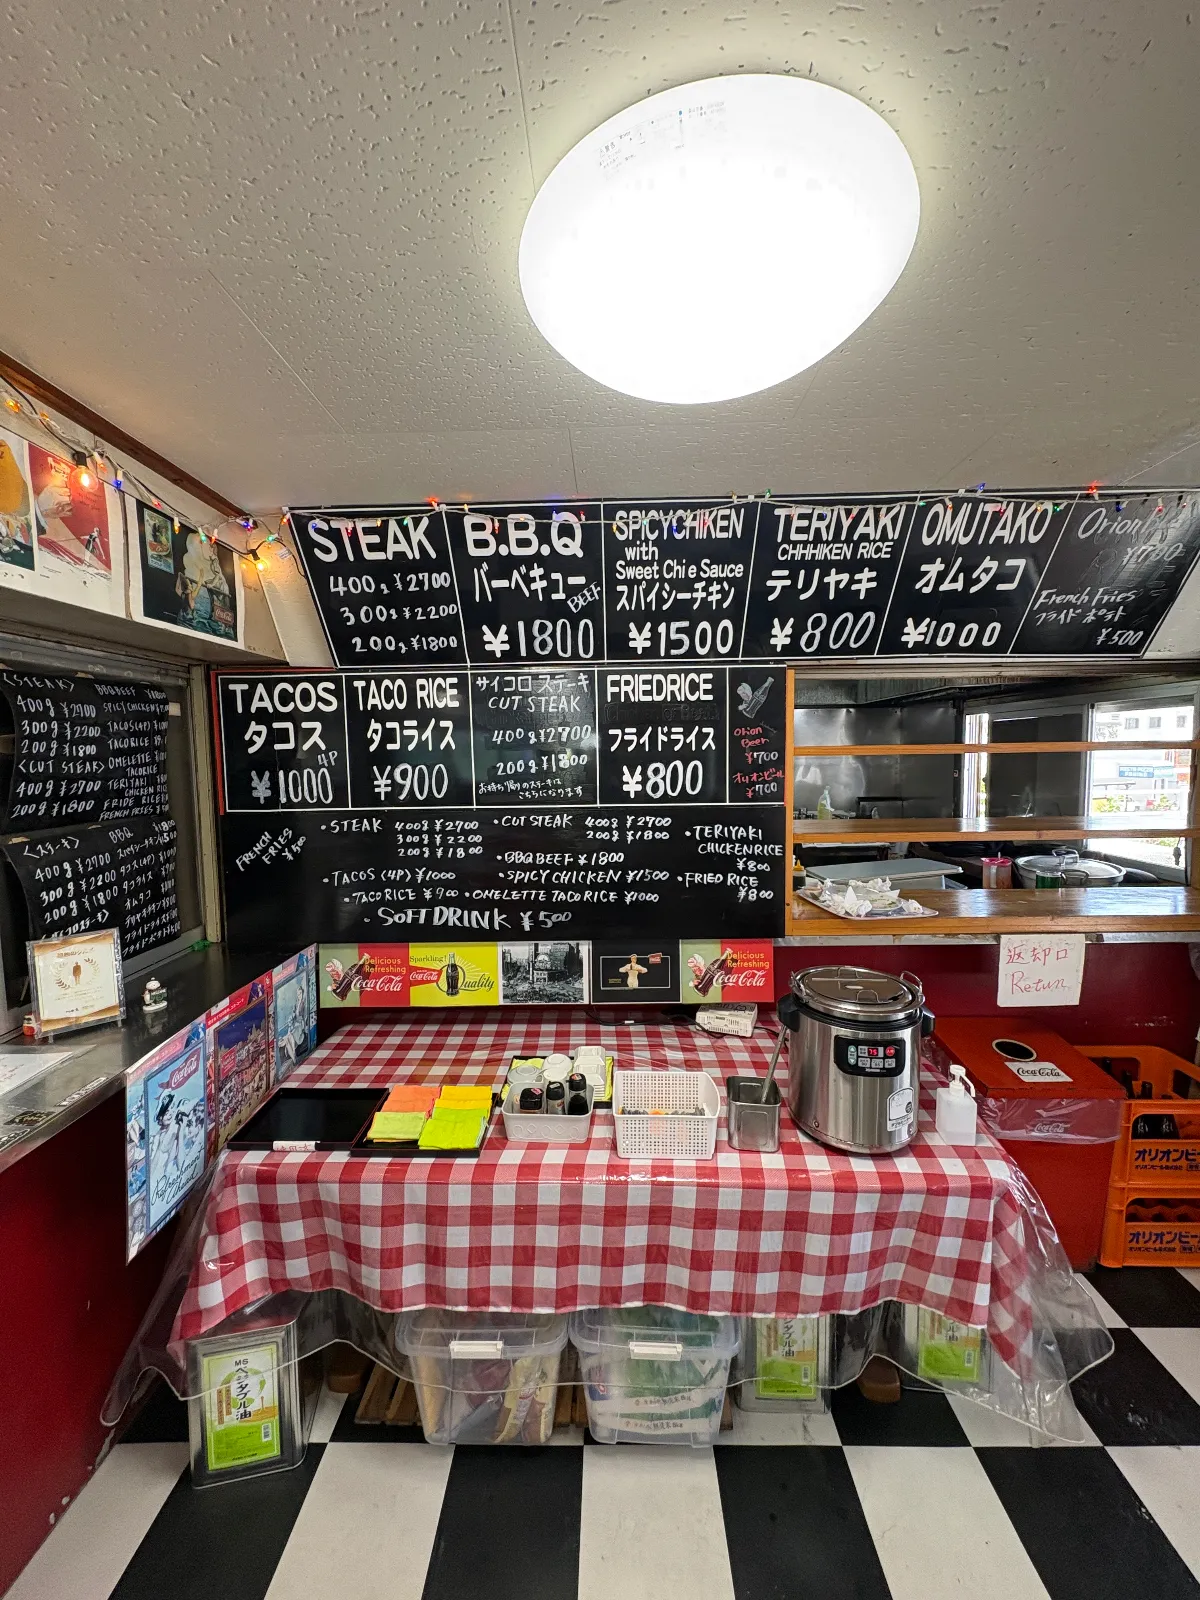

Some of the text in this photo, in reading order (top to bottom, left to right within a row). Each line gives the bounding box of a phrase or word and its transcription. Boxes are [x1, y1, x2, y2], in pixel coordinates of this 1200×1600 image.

[613, 508, 745, 541] SPICYCHIKEN
[773, 503, 907, 543] TERIYAKI
[921, 501, 1052, 546] OMUTAKO
[1077, 507, 1142, 540] Orion
[307, 516, 437, 563] STEAK
[463, 511, 584, 558] B.B.Q
[624, 540, 659, 561] with
[856, 541, 894, 560] RICE
[615, 558, 744, 580] Sweet Sauce
[914, 555, 1026, 594] オムタコ
[329, 571, 451, 597] 400g ¥2700
[473, 561, 586, 602] バーベキュー
[765, 566, 878, 602] テリヤキ
[566, 580, 602, 613] BEEF
[616, 580, 735, 612] スパイシーチキン
[1032, 586, 1138, 611] French Fries
[340, 603, 457, 626] 300g ¥2200
[481, 618, 595, 658] ¥1800
[628, 618, 734, 657] ¥1500
[769, 611, 876, 652] ¥800
[900, 617, 1001, 649] ¥1000
[1096, 627, 1144, 646] ¥500
[351, 634, 458, 654] 200g ¥1800
[228, 681, 338, 713] TACOS
[353, 677, 460, 711] TACO RICE
[606, 672, 714, 702] FRIEDRICE
[16, 694, 96, 718] 400g ¥2700
[103, 700, 155, 714] SPICY CHICKEN
[488, 694, 581, 713] CUT STEAK
[21, 719, 101, 740] 300g ¥2200
[244, 720, 327, 754] タコス
[366, 717, 456, 752] タコライス
[491, 724, 592, 745] 400g ¥2700
[608, 725, 716, 752] フライドライス
[20, 739, 97, 757] 200g ¥1800
[745, 751, 779, 765] ¥700
[108, 751, 152, 769] OMELETTE
[316, 750, 338, 768] 4P
[495, 753, 588, 776] 200g ¥1800
[15, 779, 102, 798] 400g ¥2700
[107, 776, 147, 790] TERIYAKI
[250, 767, 333, 805] ¥1000
[372, 762, 449, 801] ¥900
[622, 760, 703, 799] ¥800
[745, 781, 778, 799] ¥700
[124, 785, 154, 797] CHICKEN
[518, 785, 583, 800] こちらになります
[10, 799, 95, 819] 200g ¥1800
[98, 804, 154, 822] FRENCH FRIES
[330, 817, 479, 833] STEAK 400g ¥2700
[501, 813, 673, 829] CUT STEAK 400g ¥2700
[108, 826, 134, 844] BBQ
[396, 833, 483, 846] 300g ¥2200
[585, 829, 670, 845] 200g ¥1800
[692, 824, 763, 841] TERIYAKI
[235, 831, 273, 872] FRENCH
[261, 827, 293, 865] FRIES
[281, 836, 307, 861] ¥500
[397, 846, 483, 859] 200g ¥1800
[34, 852, 111, 883] 400g ¥2700
[577, 851, 625, 866] ¥1800
[736, 857, 771, 872] ¥800
[331, 867, 456, 887] TACOS ¥1000
[506, 868, 670, 885] SPICY CHICKEN ¥1500
[683, 872, 759, 888] FRIED RICE
[39, 869, 116, 907] 300g ¥2200
[422, 887, 459, 901] ¥900
[472, 889, 660, 905] OMELETTE ¥1000
[736, 886, 774, 903] ¥800
[44, 885, 118, 925] 200g ¥1800
[519, 910, 572, 932] ¥500
[364, 956, 402, 966] Delicious
[727, 951, 765, 960] Delicious
[727, 959, 770, 970] Refreshing
[1005, 944, 1069, 966] 返却口
[365, 964, 407, 974] Refreshing
[234, 1358, 249, 1366] MS
